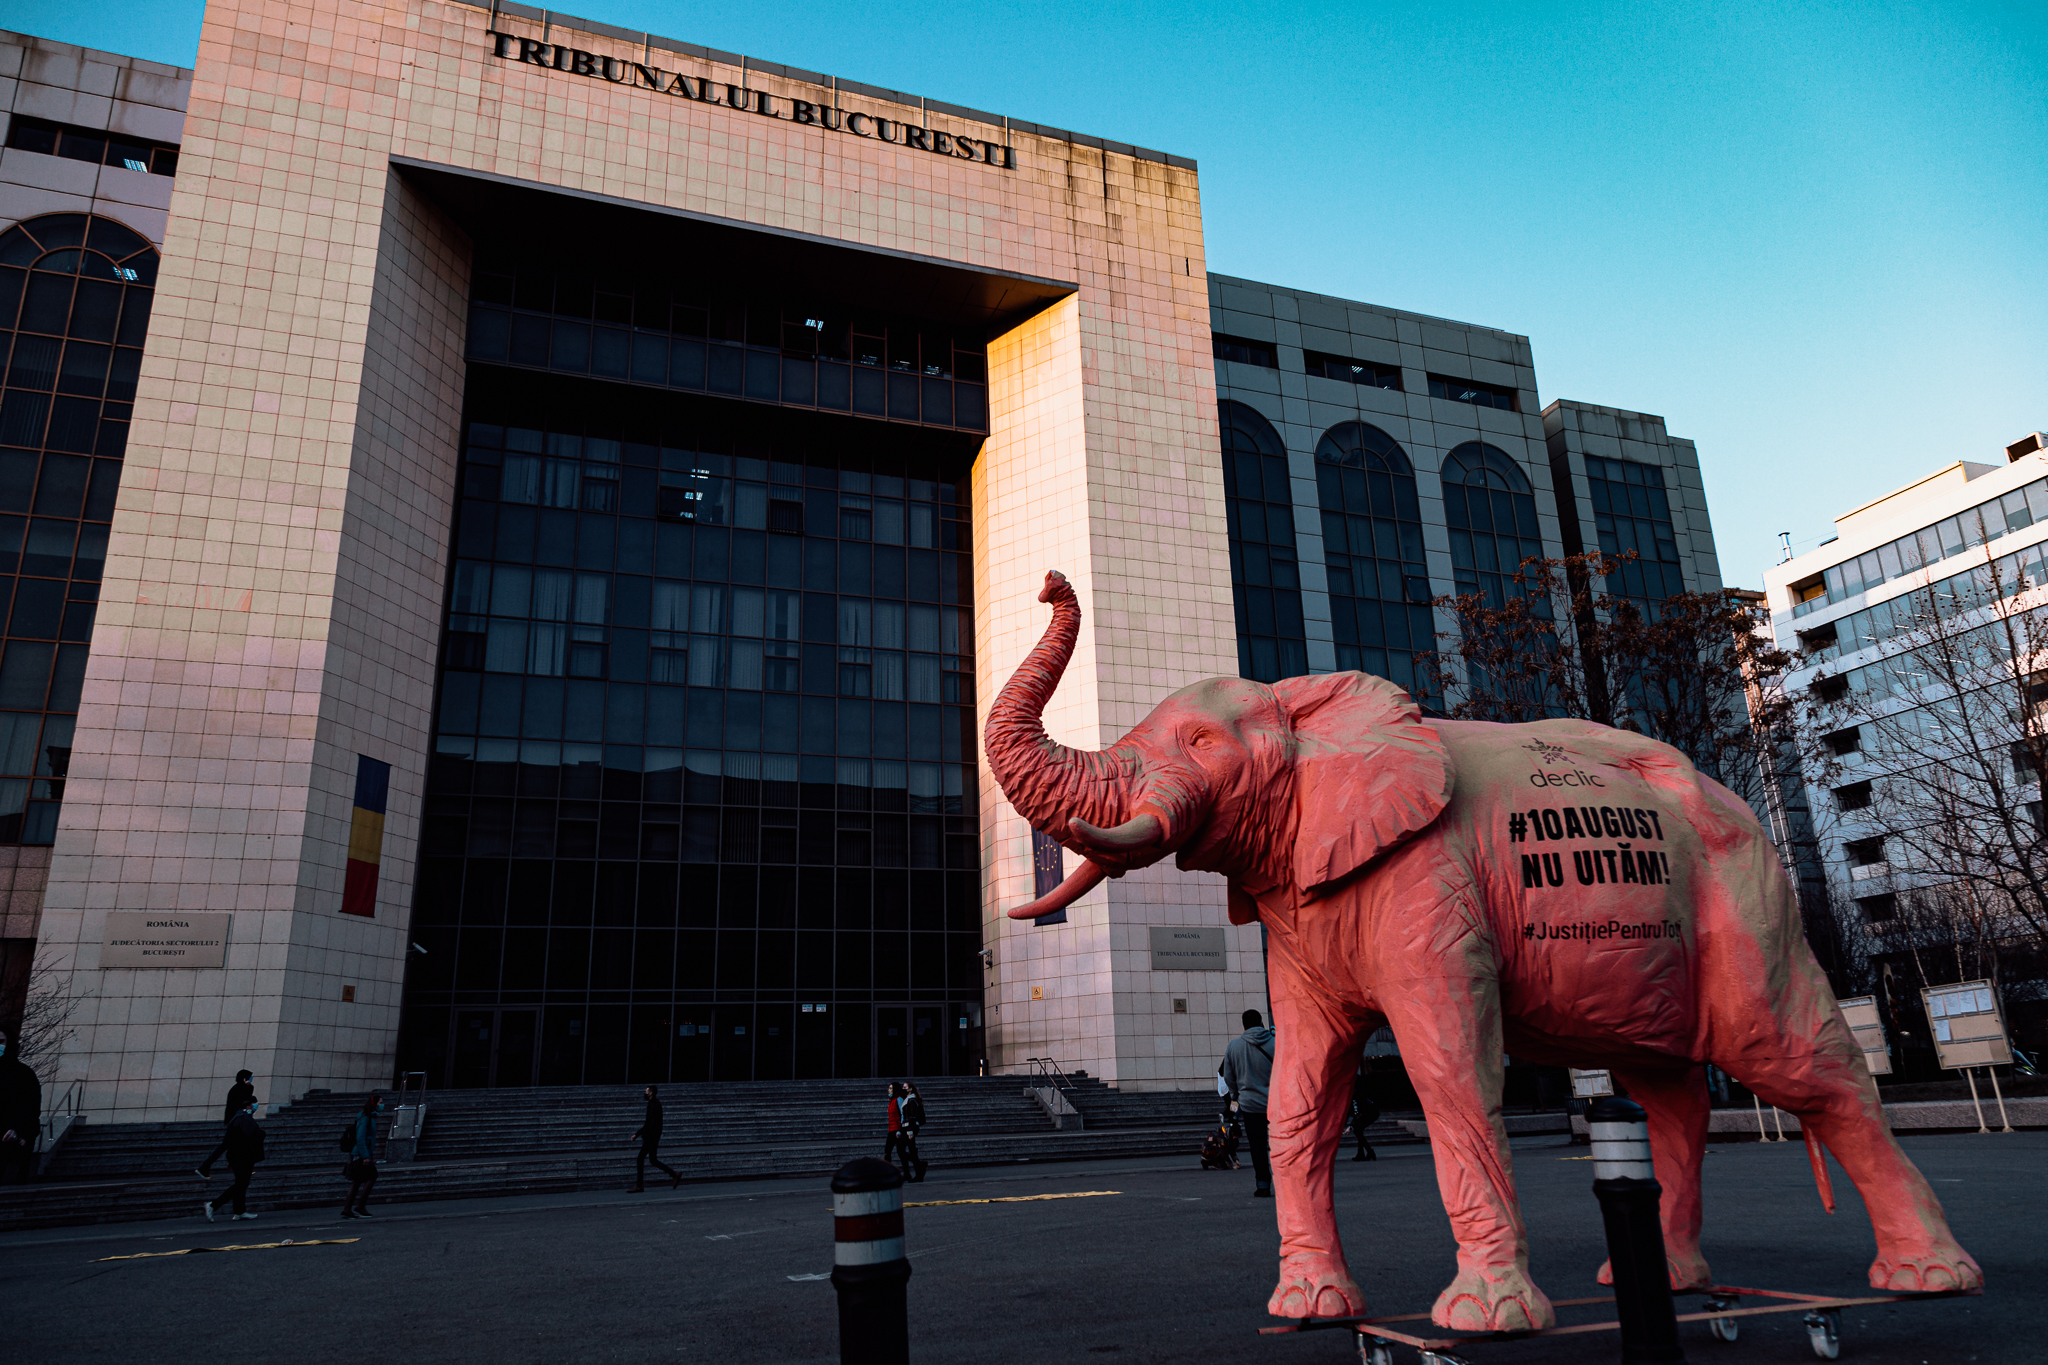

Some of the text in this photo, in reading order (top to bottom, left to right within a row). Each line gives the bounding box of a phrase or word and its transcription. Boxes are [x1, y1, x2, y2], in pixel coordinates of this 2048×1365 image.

[486, 29, 1016, 170] TRIBUNALUL BUCURESTI
[1529, 768, 1606, 788] declic
[1508, 806, 1665, 843] #10AUGUST
[1521, 842, 1671, 888] NU UITĂM!
[146, 919, 190, 928] ROMÂNIA
[165, 939, 215, 947] SECTORULUI
